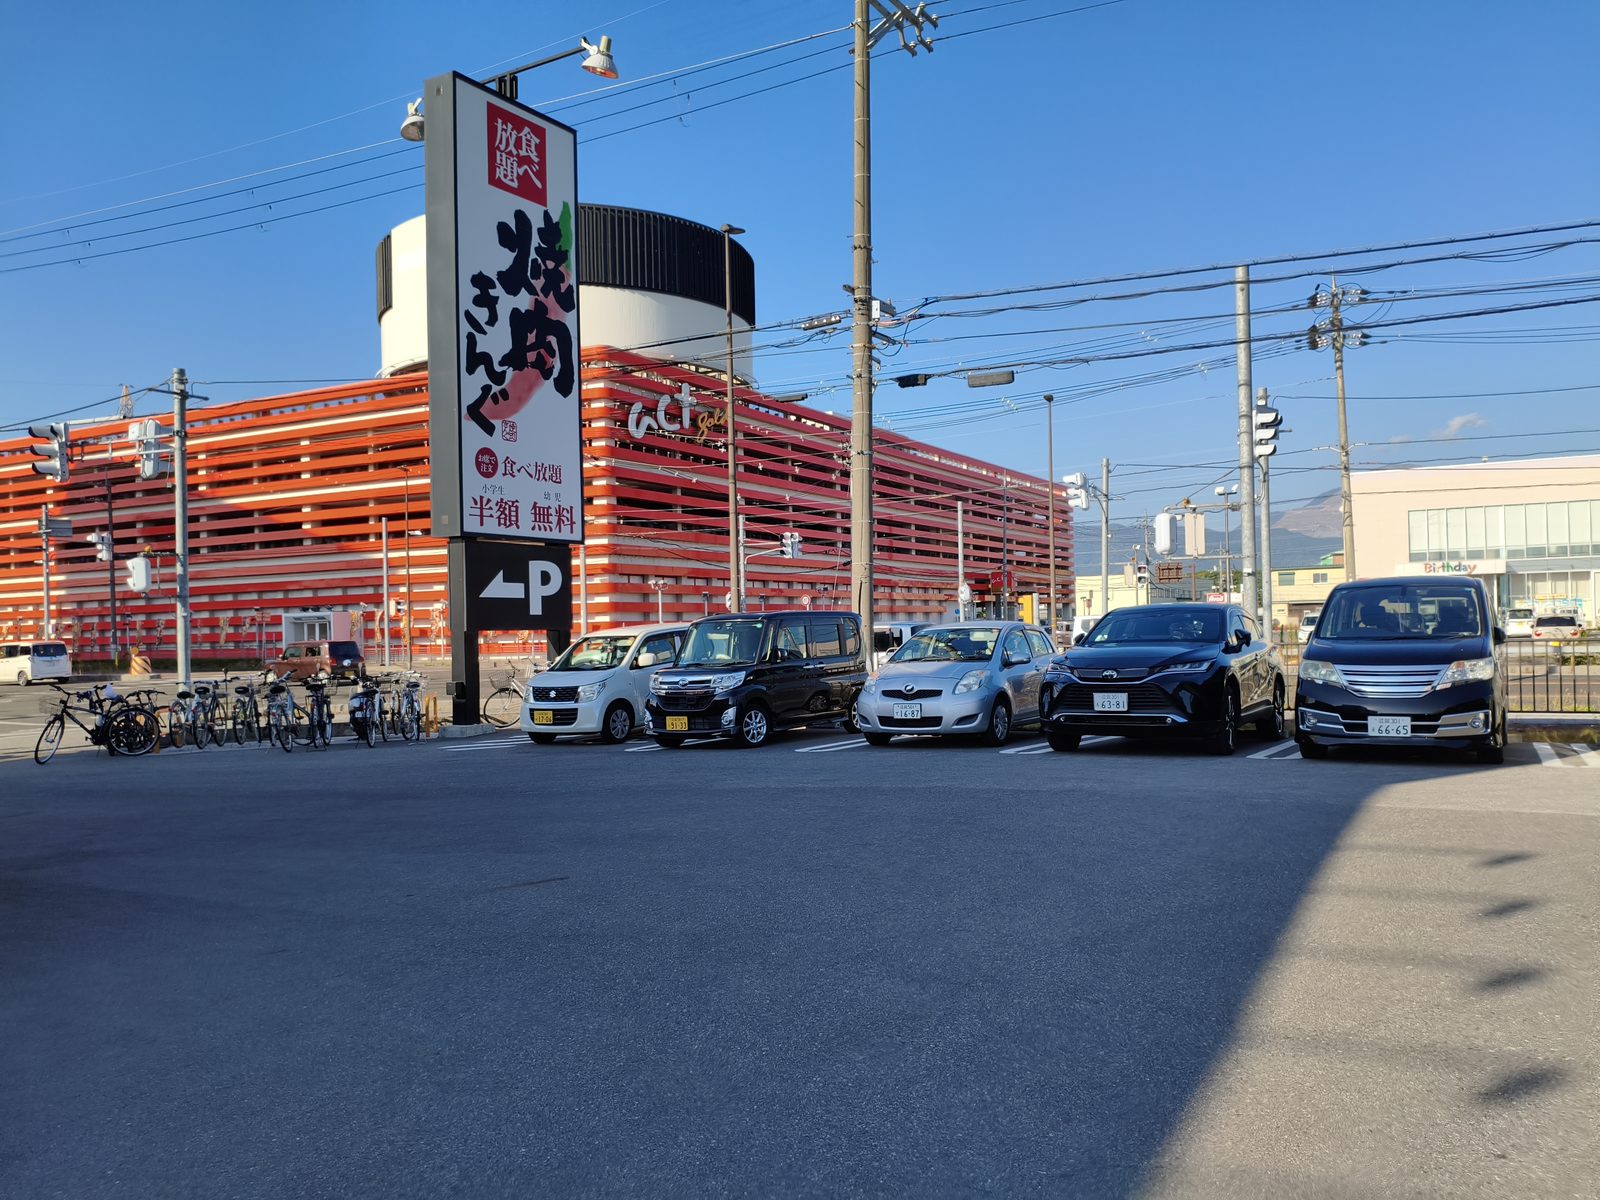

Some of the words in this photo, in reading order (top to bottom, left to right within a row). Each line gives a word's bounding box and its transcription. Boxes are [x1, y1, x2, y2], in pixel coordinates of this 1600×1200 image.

[495, 117, 519, 189] 放題
[517, 127, 543, 190] 食べ
[497, 208, 576, 399] 焼肉
[464, 271, 509, 438] きんぐ
[480, 463, 494, 473] 注文
[501, 456, 563, 485] 食べ放題
[482, 484, 505, 495] 小学生
[469, 495, 520, 530] 半額
[530, 501, 577, 535] 無料
[1424, 562, 1477, 576] Birthday
[528, 560, 563, 616] P
[900, 709, 920, 718] 16-87
[1101, 700, 1125, 709] 63-81
[1377, 724, 1409, 735] 66-65
